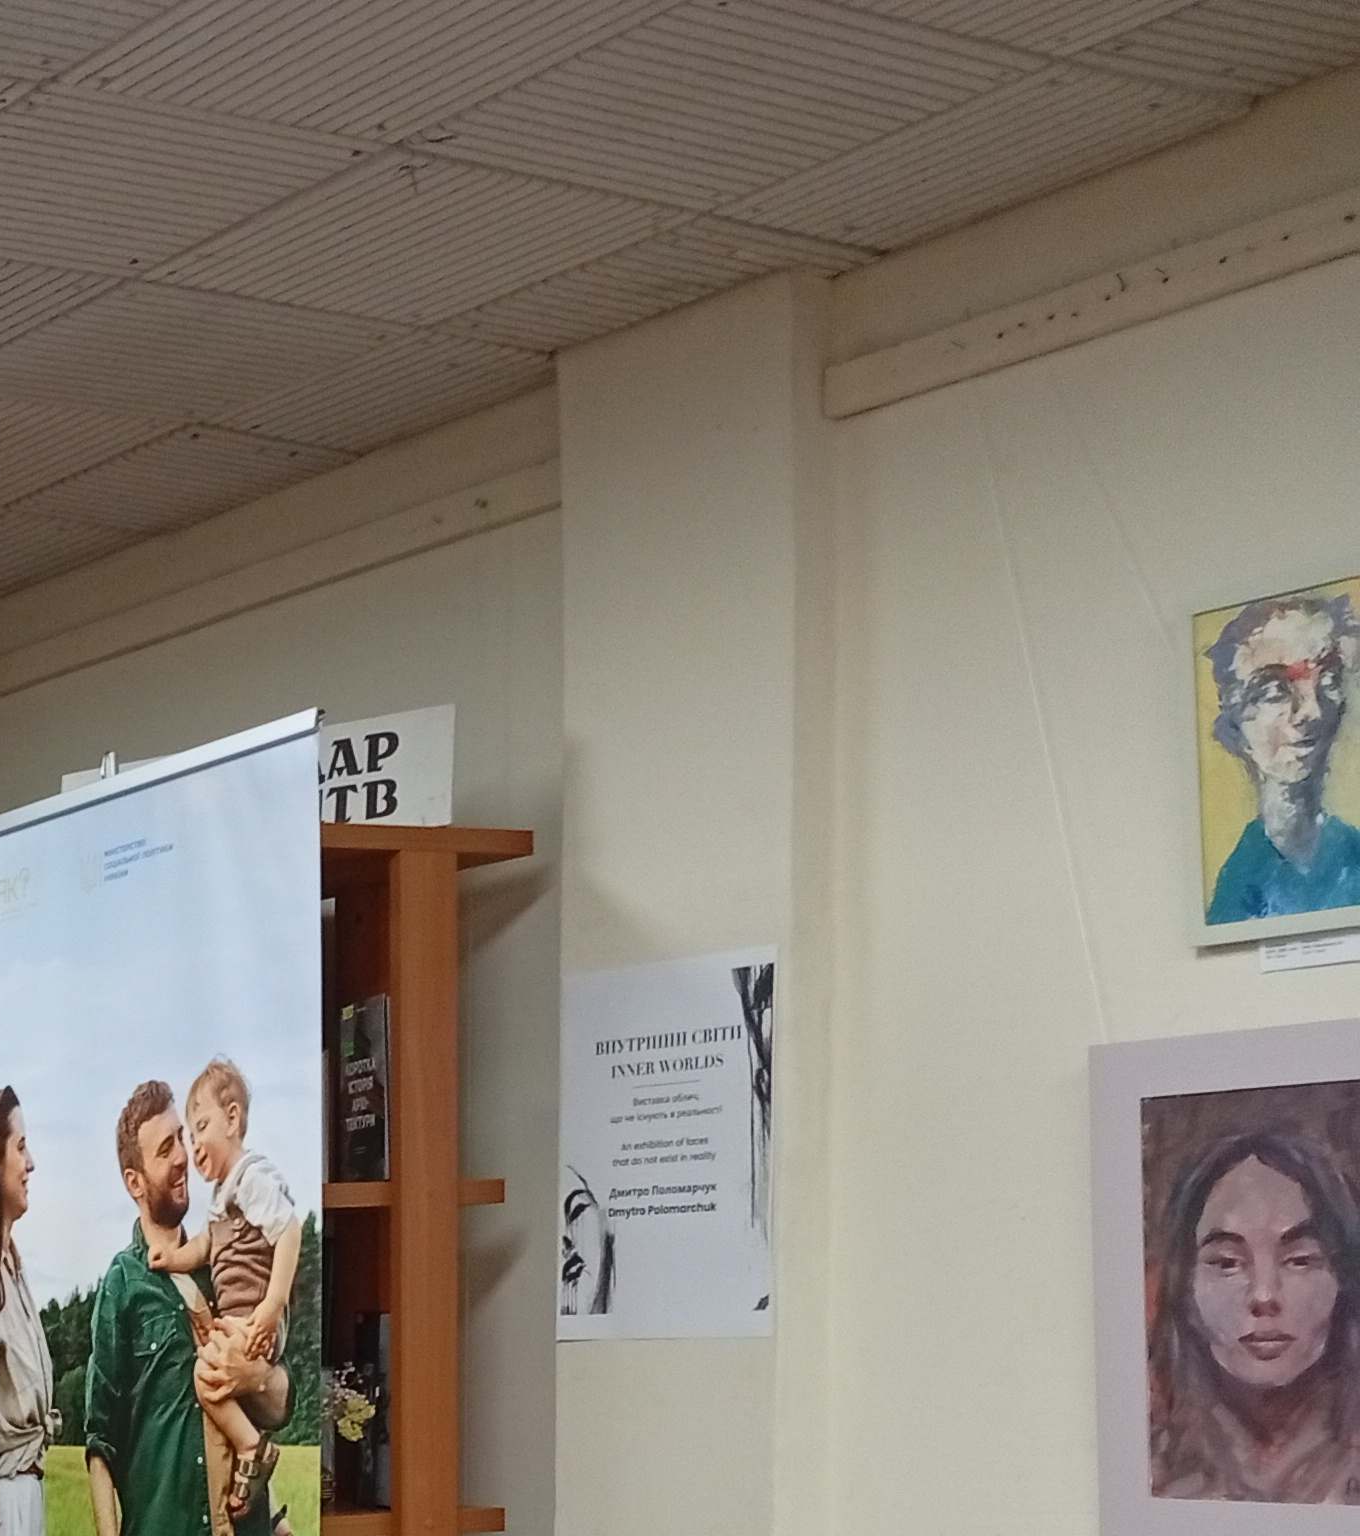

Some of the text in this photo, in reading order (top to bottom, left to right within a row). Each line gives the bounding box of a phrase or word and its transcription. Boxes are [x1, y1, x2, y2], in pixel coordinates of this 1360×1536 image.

[691, 1025, 742, 1045] СВІТИ
[611, 1053, 725, 1079] INNER WORLDS
[609, 1187, 650, 1200] Дмитро
[608, 1202, 717, 1220] Dmytro Polomarchuk
